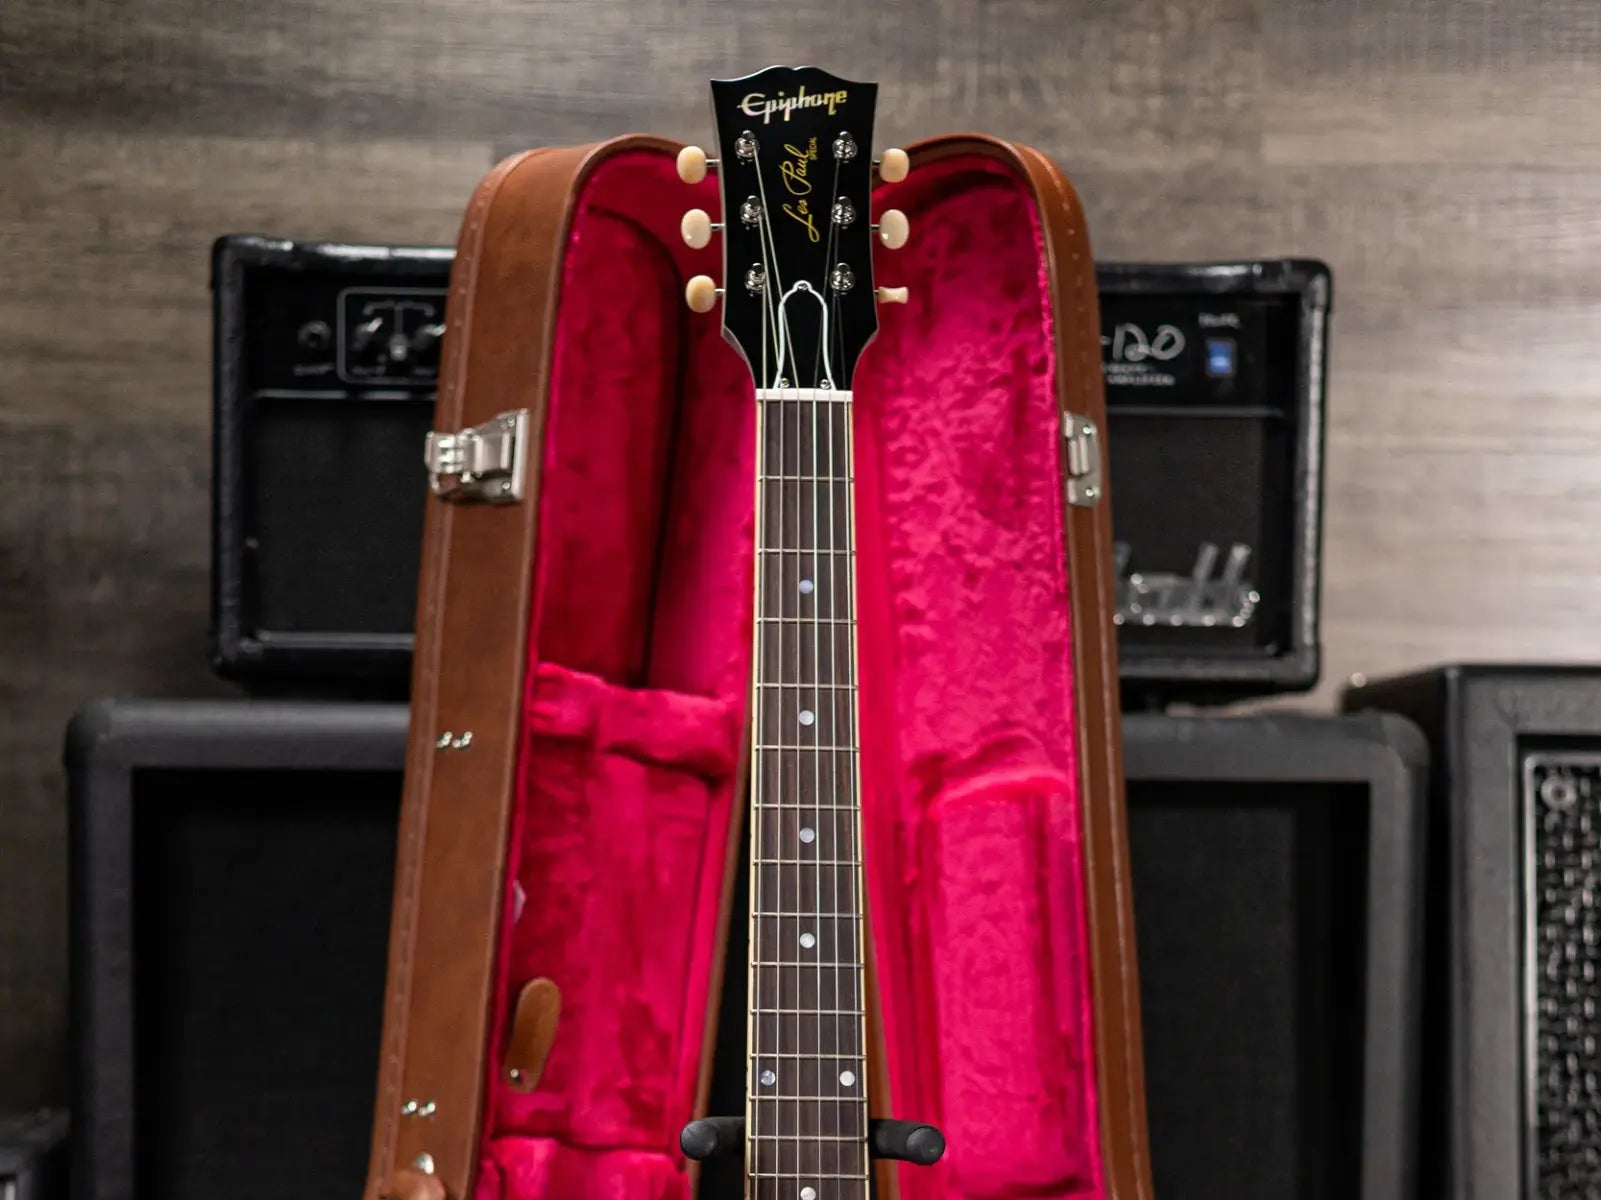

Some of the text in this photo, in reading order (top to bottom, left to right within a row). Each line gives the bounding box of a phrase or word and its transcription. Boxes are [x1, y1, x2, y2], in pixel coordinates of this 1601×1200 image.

[736, 85, 848, 125] Epiphone
[779, 143, 820, 243] Les Paul
